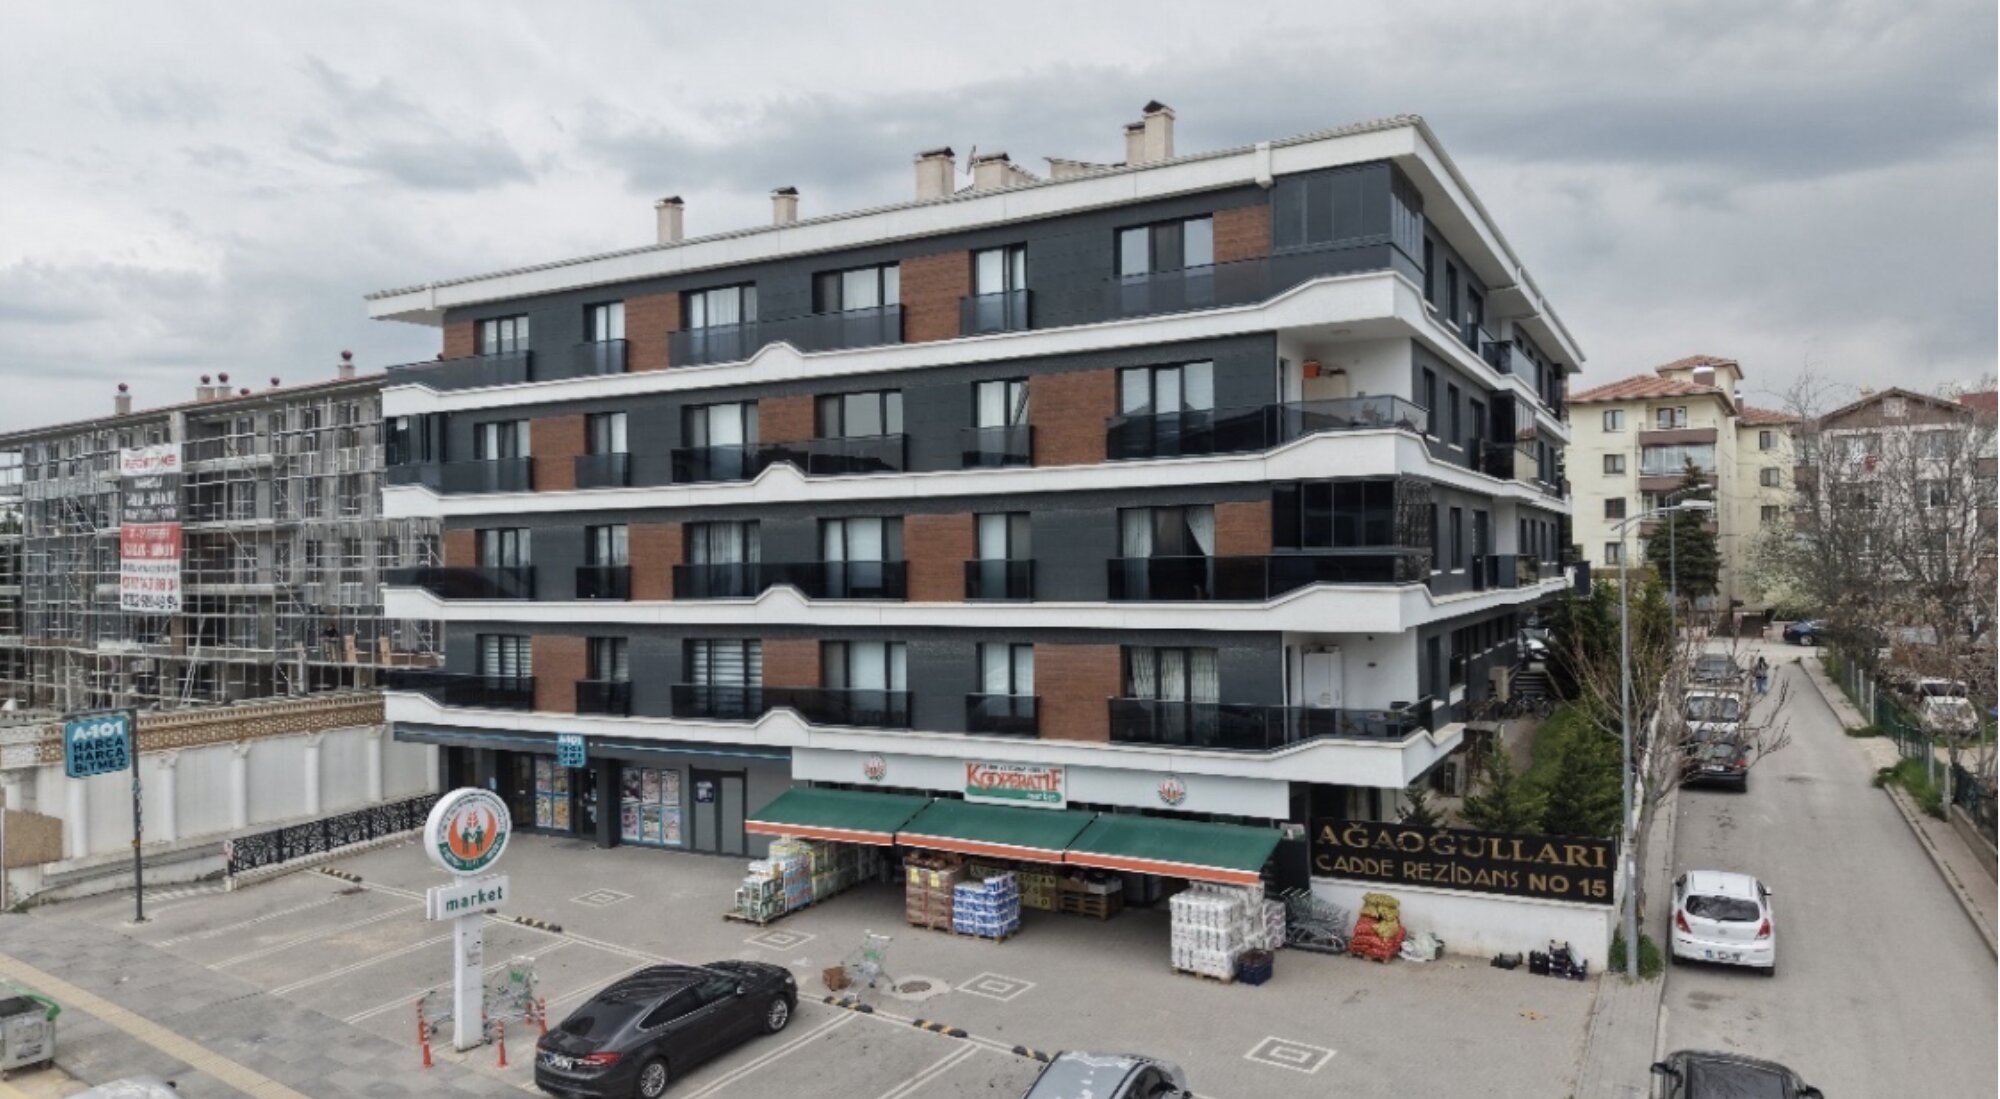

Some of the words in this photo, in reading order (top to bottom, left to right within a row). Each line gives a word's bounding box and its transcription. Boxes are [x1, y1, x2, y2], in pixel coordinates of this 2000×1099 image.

[73, 736, 124, 753] HARCA
[74, 747, 125, 762] HARCA
[1316, 822, 1608, 869] AĞAOĞULLARI
[1315, 854, 1394, 877] CADDE
[1403, 861, 1519, 888] REZİDANS
[1528, 873, 1569, 893] NO
[1579, 878, 1607, 898] 15
[446, 886, 502, 911] market
